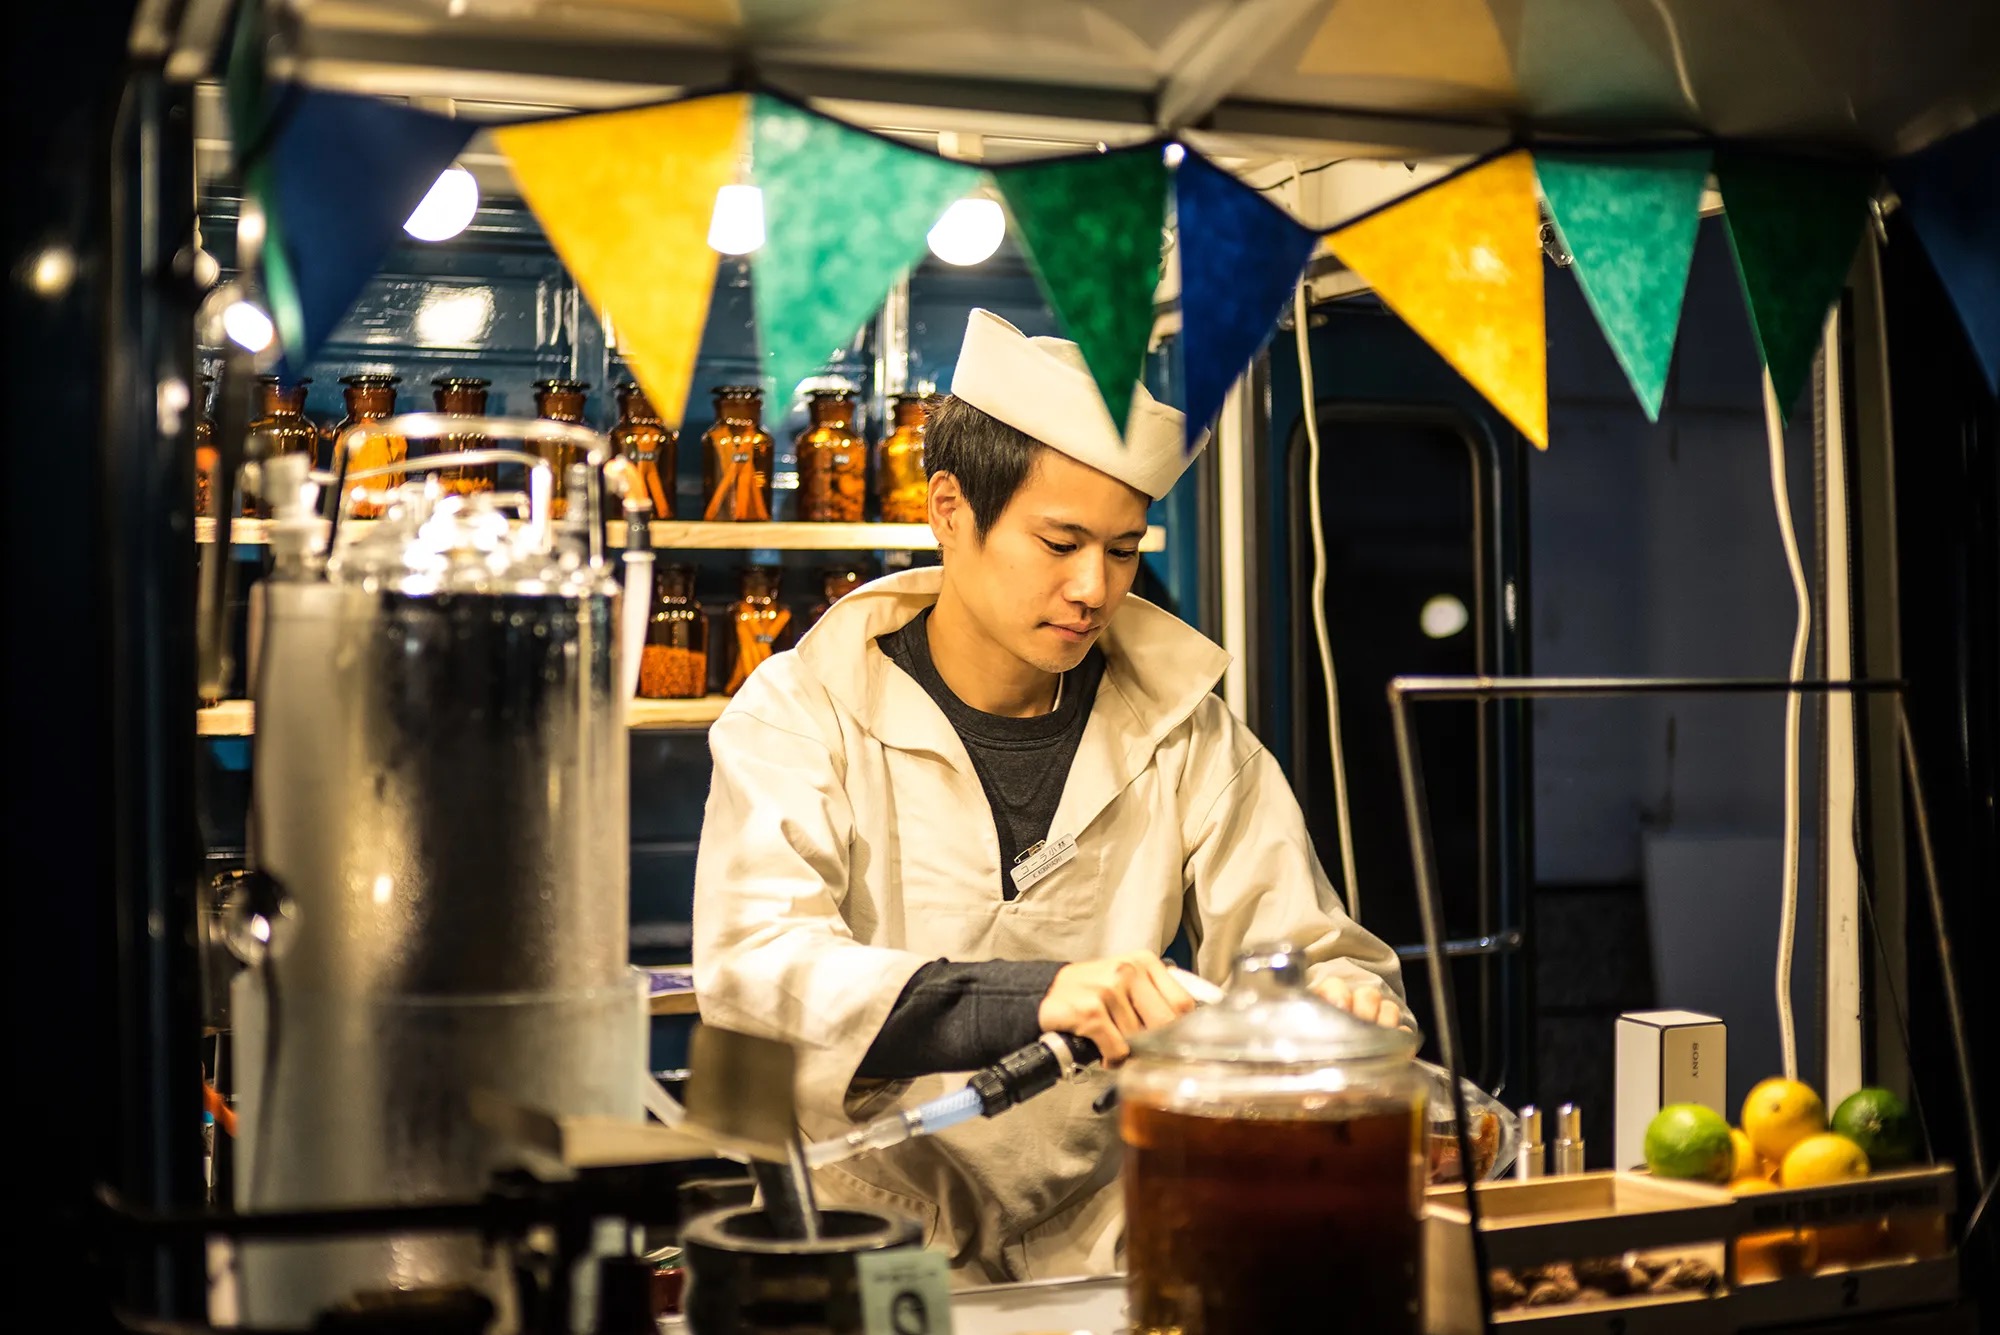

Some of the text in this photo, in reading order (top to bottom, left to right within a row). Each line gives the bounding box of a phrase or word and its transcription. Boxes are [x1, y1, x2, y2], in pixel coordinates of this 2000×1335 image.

[1021, 841, 1066, 875] コーラ小林
